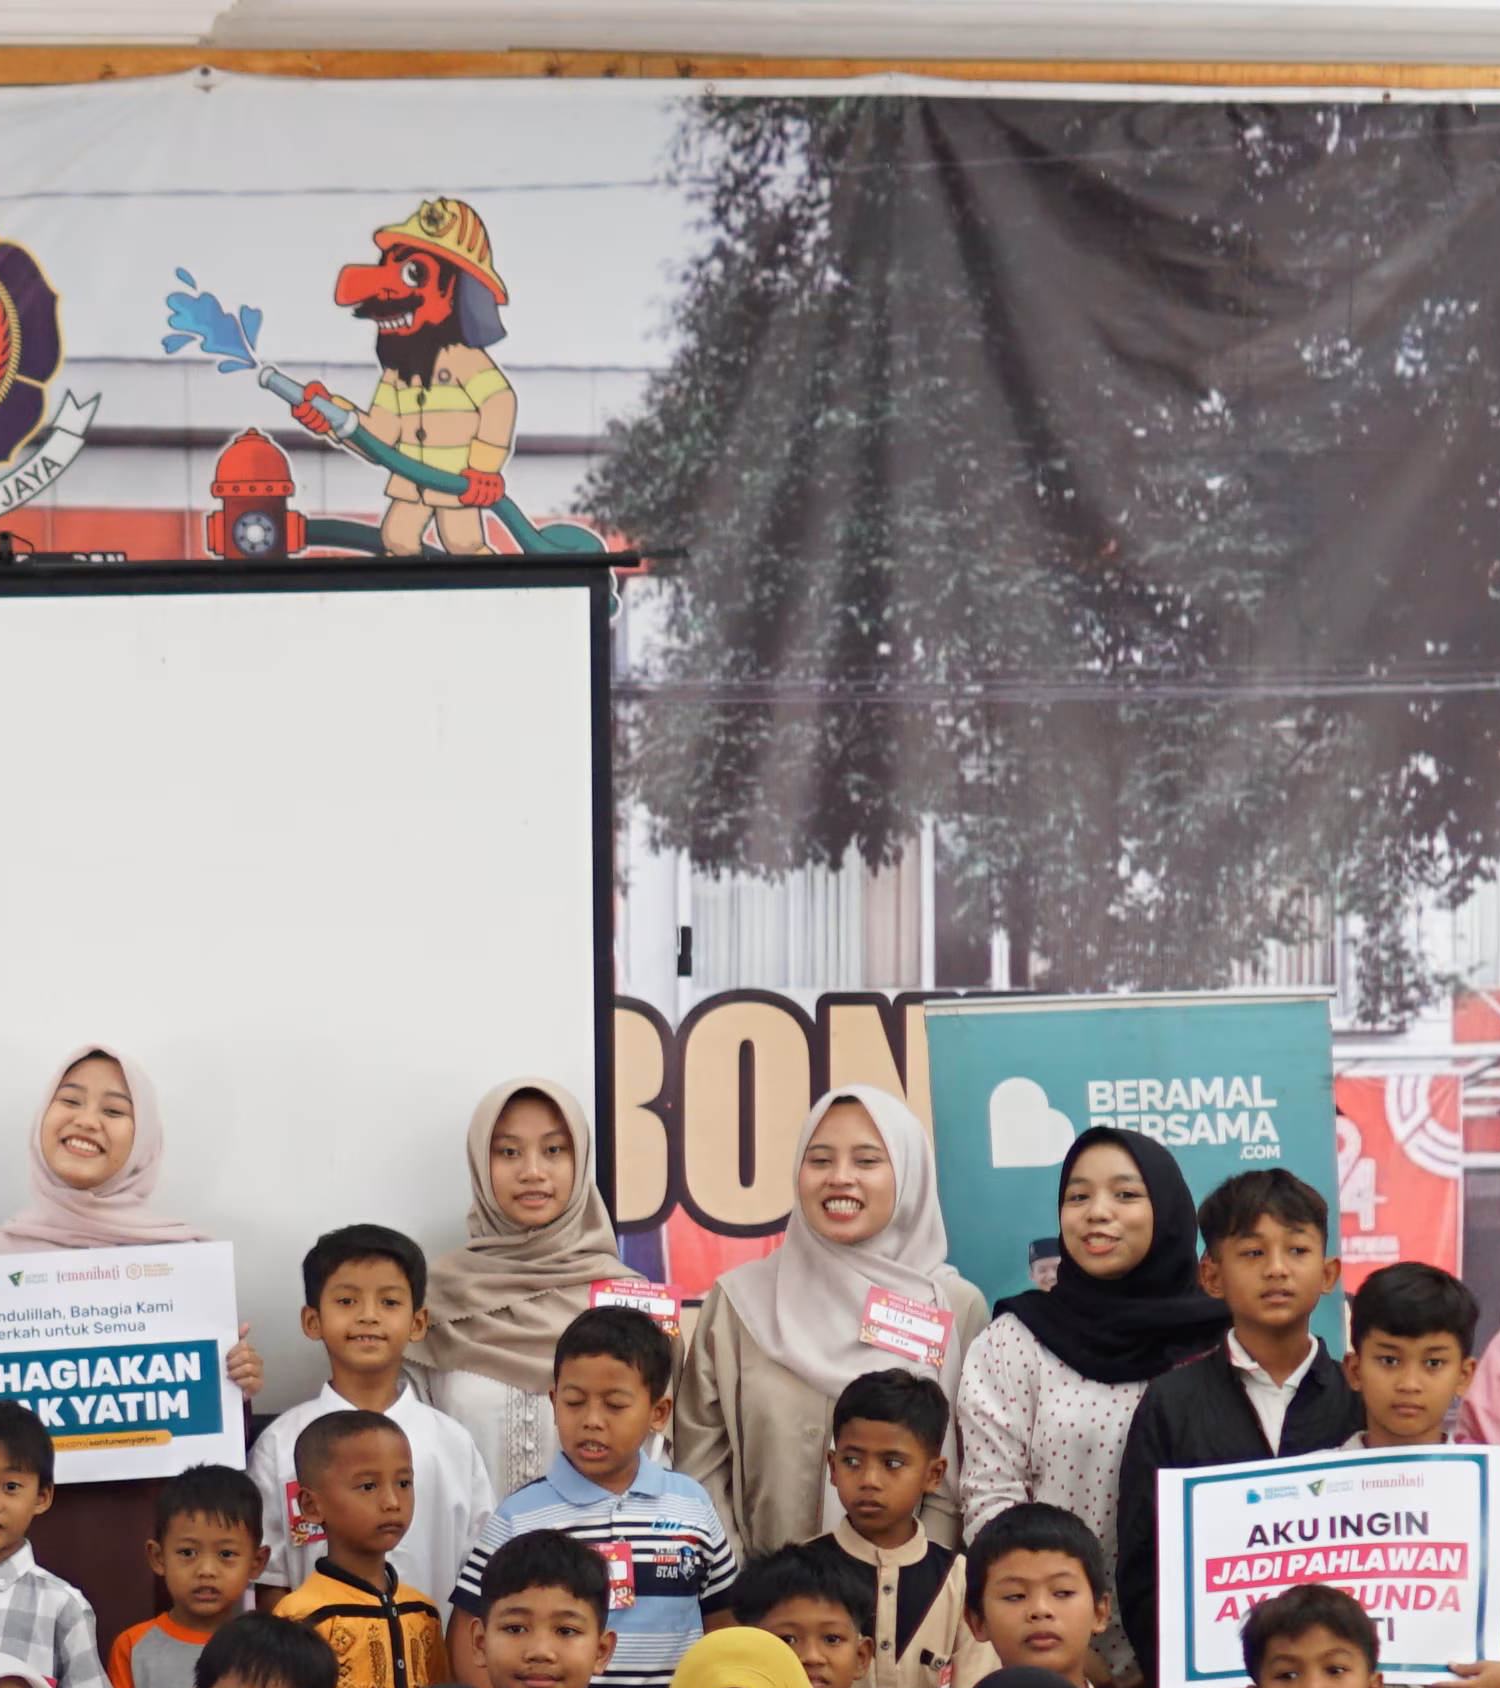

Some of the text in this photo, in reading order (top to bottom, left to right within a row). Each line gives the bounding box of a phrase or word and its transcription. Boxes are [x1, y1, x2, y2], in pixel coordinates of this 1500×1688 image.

[2, 454, 63, 508] JAYA
[1087, 1075, 1278, 1113] BERAMAL
[1240, 1145, 1281, 1159] .COM
[70, 1303, 132, 1319] Bahagia
[136, 1300, 174, 1314] Kami
[45, 1322, 90, 1337] untuk
[94, 1319, 147, 1334] Semua
[69, 1390, 190, 1426] YATIM
[1247, 1511, 1430, 1548] AKU INGIN
[1212, 1547, 1463, 1586] JADI PAHLAWAN
